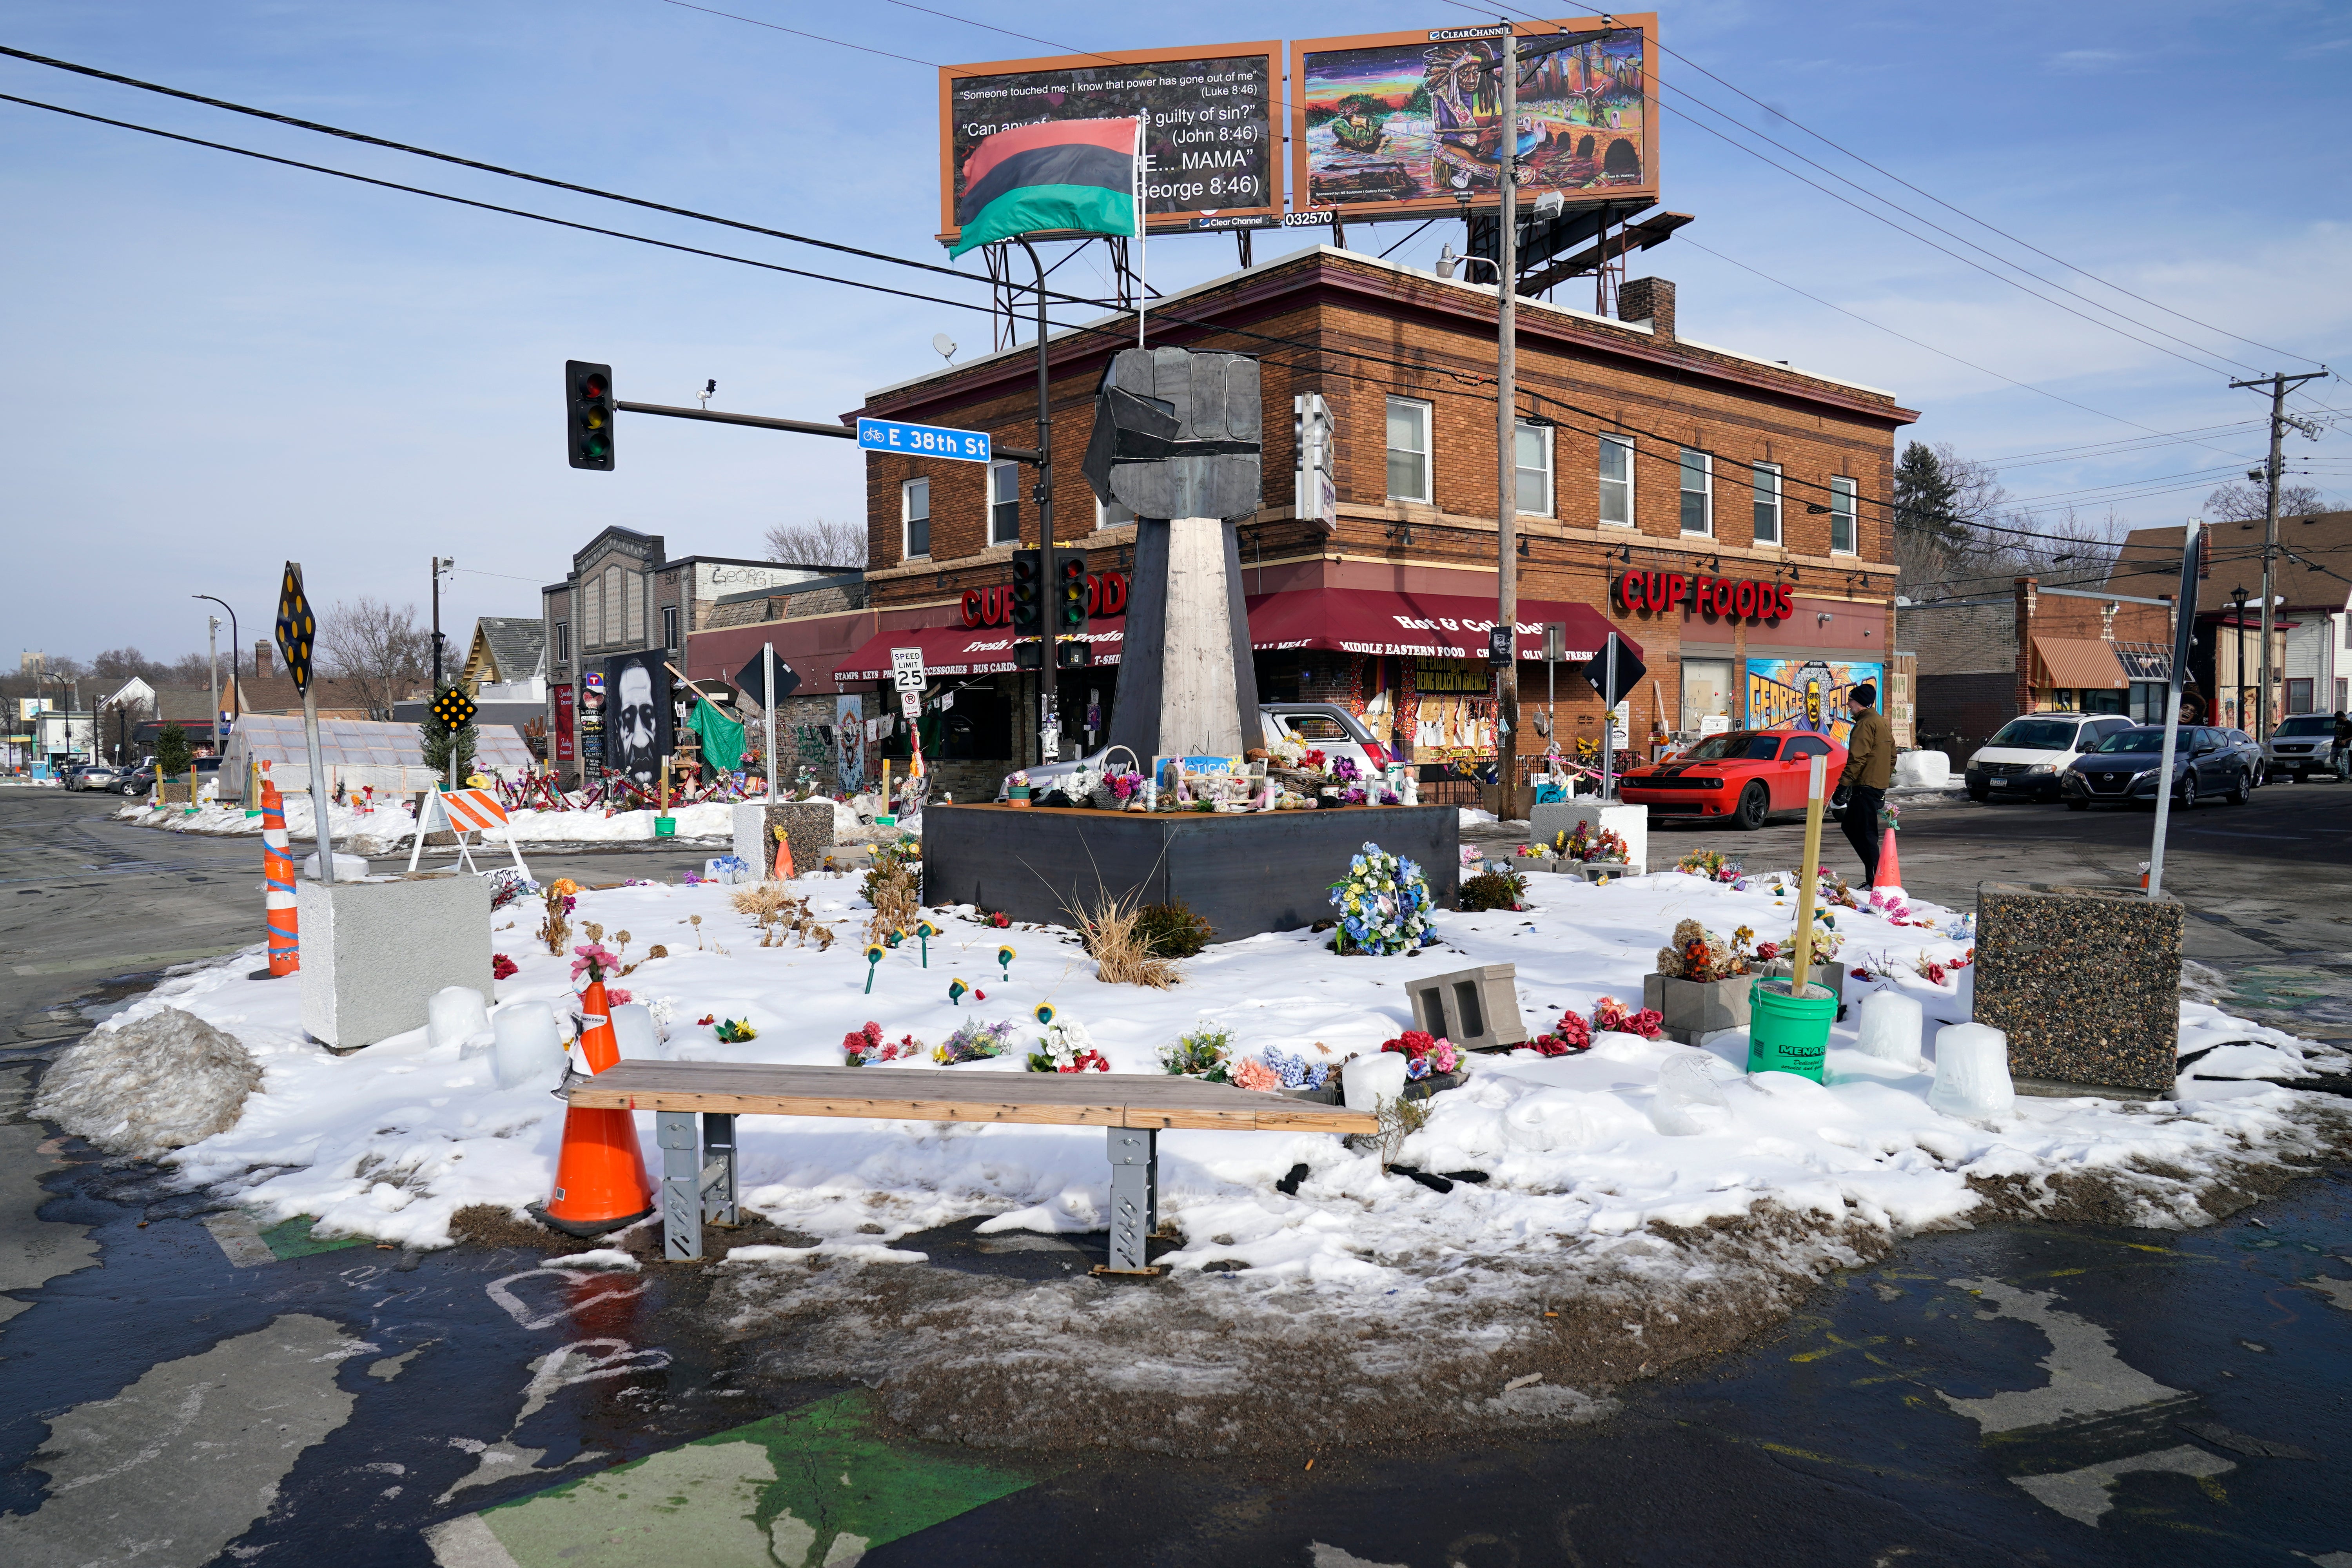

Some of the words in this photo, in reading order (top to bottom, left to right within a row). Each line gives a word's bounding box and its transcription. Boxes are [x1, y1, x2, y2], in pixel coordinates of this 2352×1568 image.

[960, 90, 1007, 100] “Someone
[1011, 85, 1048, 96] touched
[1051, 85, 1069, 94] me;
[1072, 83, 1074, 92] I
[1078, 82, 1103, 91] know
[1105, 79, 1124, 89] that
[1127, 78, 1156, 91] power
[1159, 77, 1177, 86] has
[1180, 75, 1204, 87] gone
[1207, 73, 1223, 83] out
[1225, 72, 1235, 82] of
[1238, 71, 1257, 80] me”
[1201, 87, 1229, 99] (Luke
[1232, 84, 1258, 96] 8:46)
[1156, 109, 1195, 127] guilty
[1200, 107, 1215, 121] of
[1219, 104, 1255, 120] sin?”
[962, 123, 996, 137] “Can
[1172, 129, 1214, 147] (John
[1219, 125, 1258, 142] 8:46)
[1182, 149, 1253, 170] MAMA”
[1210, 175, 1259, 197] 8:46)
[1232, 216, 1262, 225] Channel
[1285, 211, 1332, 226] 032570
[889, 428, 901, 446] E
[910, 431, 957, 452] 38th
[965, 437, 985, 456] St
[1621, 570, 1686, 612] CUP
[1697, 576, 1794, 620] FOODS
[1392, 615, 1439, 630] Hot
[1439, 618, 1459, 631] &
[963, 639, 1010, 653] Fresh
[1277, 638, 1312, 650] MEAT
[1339, 641, 1383, 655] MIDDLE
[1385, 644, 1435, 657] EASTERN
[1437, 646, 1465, 658] FOOD
[1565, 651, 1593, 660] FRESH
[834, 671, 859, 681] STAMPS
[862, 670, 878, 679] KEYS
[924, 665, 967, 675] CCESSORIES
[973, 663, 988, 673] BUS
[990, 661, 1017, 672] CARDS
[898, 670, 922, 686] 25
[1416, 672, 1434, 690] BEING
[1455, 673, 1461, 690] IN
[1463, 673, 1487, 691] AMERICA
